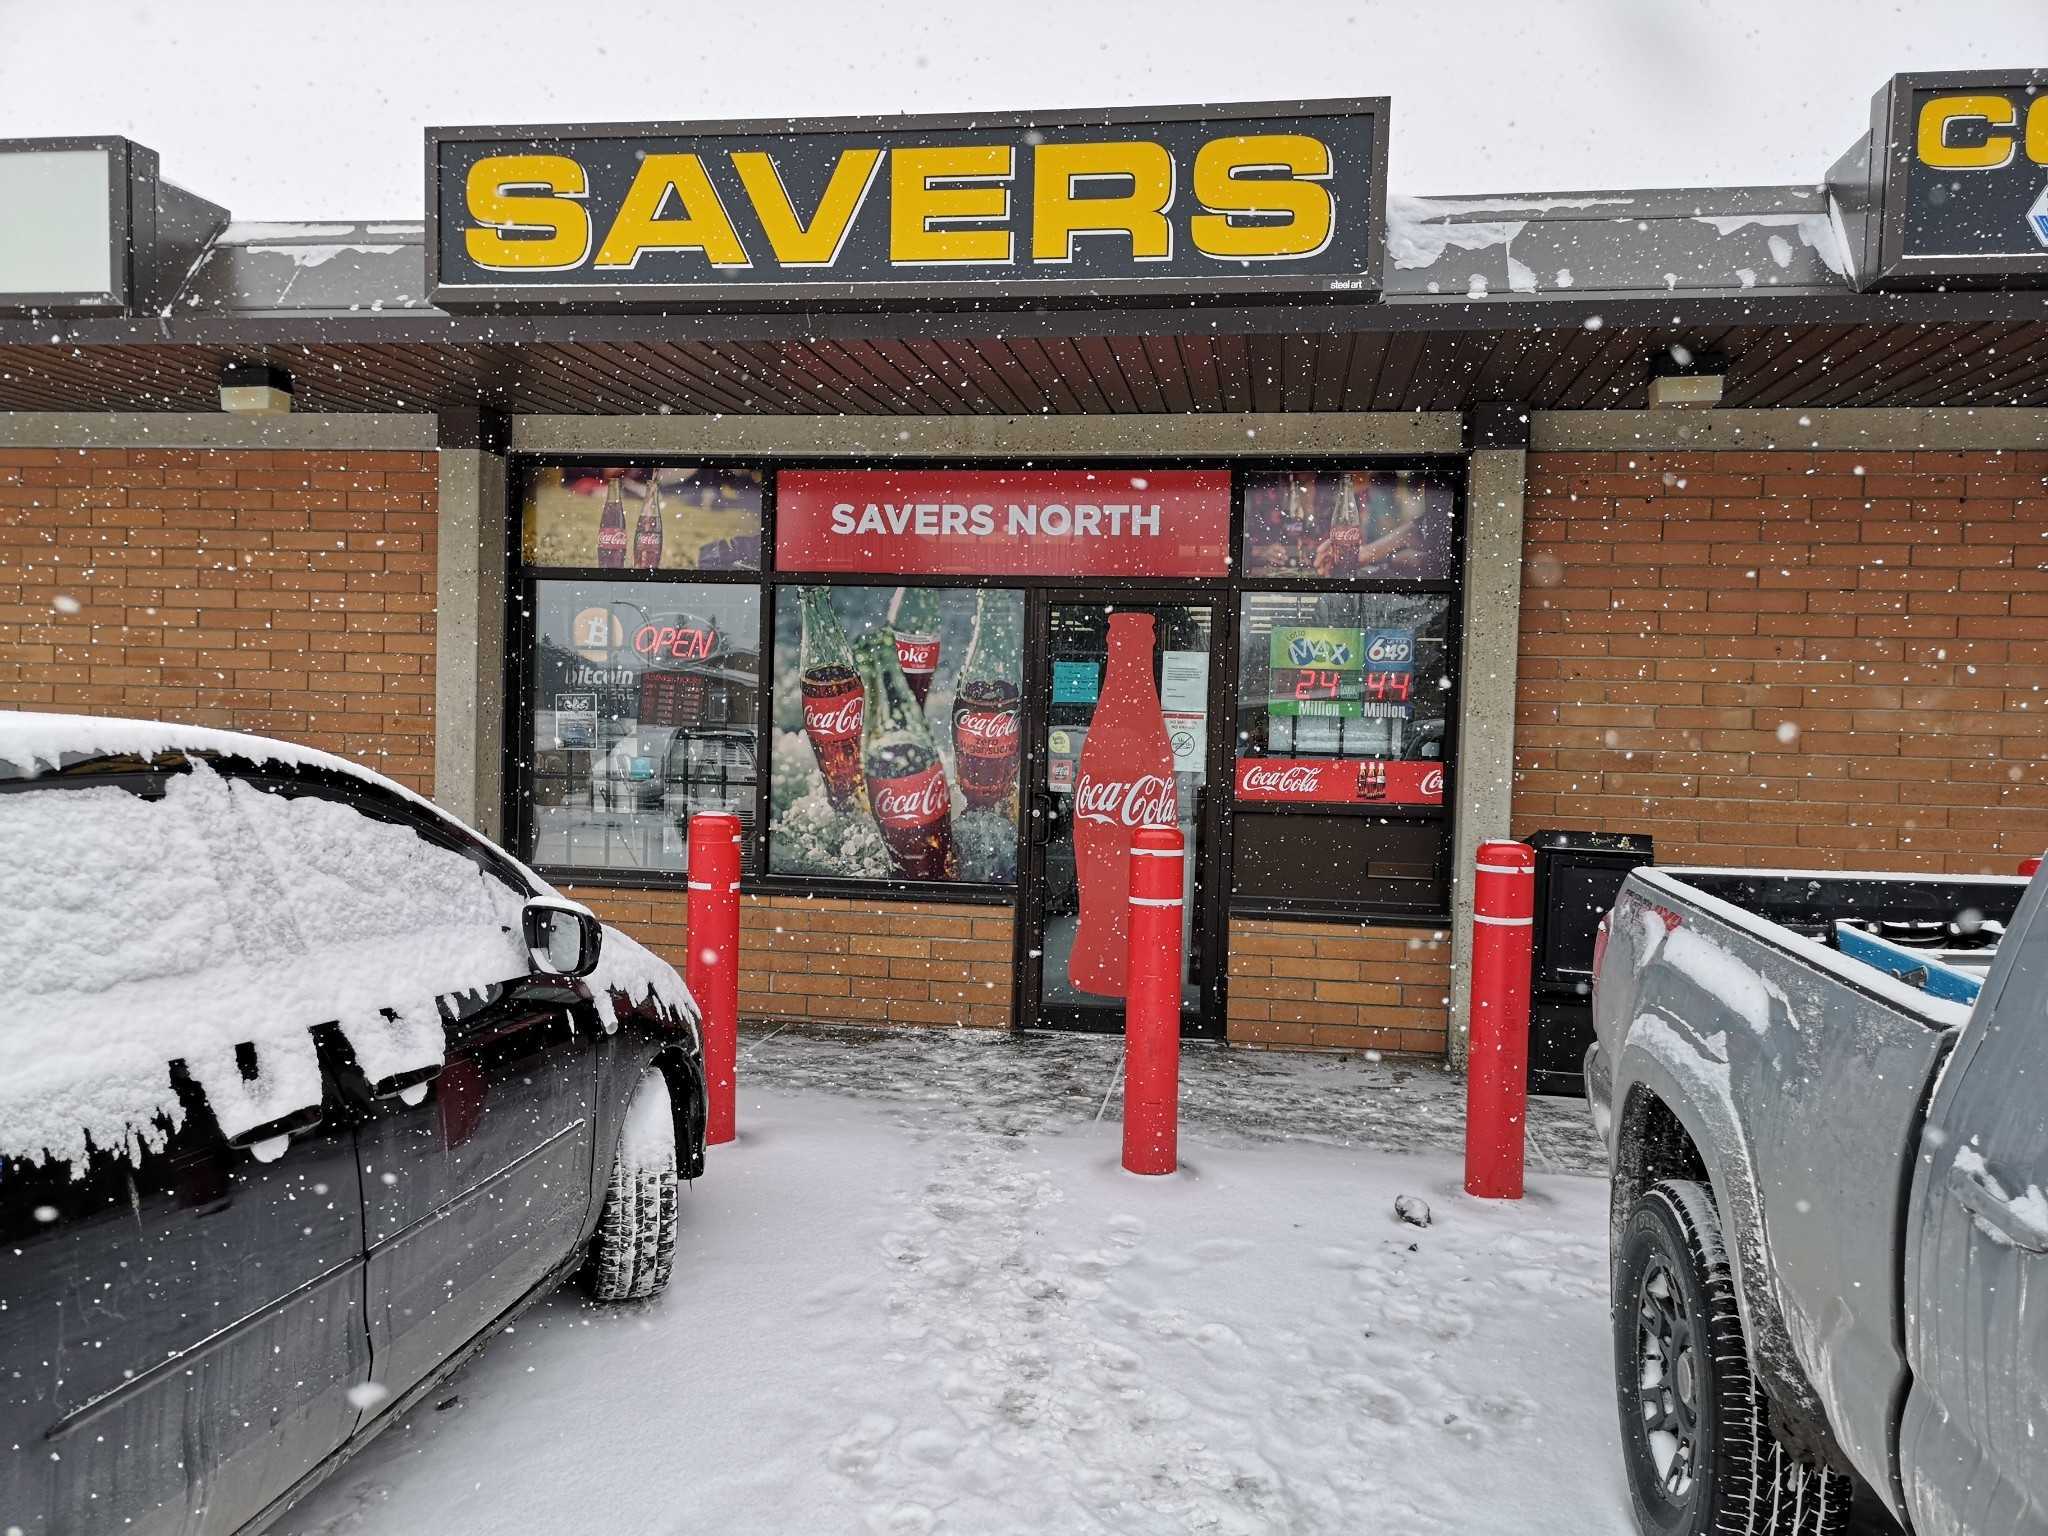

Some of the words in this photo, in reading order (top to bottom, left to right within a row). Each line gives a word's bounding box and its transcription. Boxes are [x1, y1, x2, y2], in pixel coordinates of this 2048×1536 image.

[1918, 96, 2048, 169] C
[465, 134, 1336, 271] SAVERS
[1330, 280, 1350, 289] steel
[1351, 280, 1362, 289] art
[832, 503, 994, 536] SAVERS
[1007, 504, 1161, 537] NORTH
[635, 626, 714, 660] OPEN
[1288, 638, 1347, 665] MAX
[564, 664, 634, 685] bitcoin
[1296, 669, 1341, 701] 24
[1367, 671, 1412, 701] 44
[1299, 699, 1341, 716] Million
[1364, 701, 1407, 719] Million
[1242, 765, 1324, 793] Coca-Cola
[1076, 774, 1177, 827] Coca-Cola
